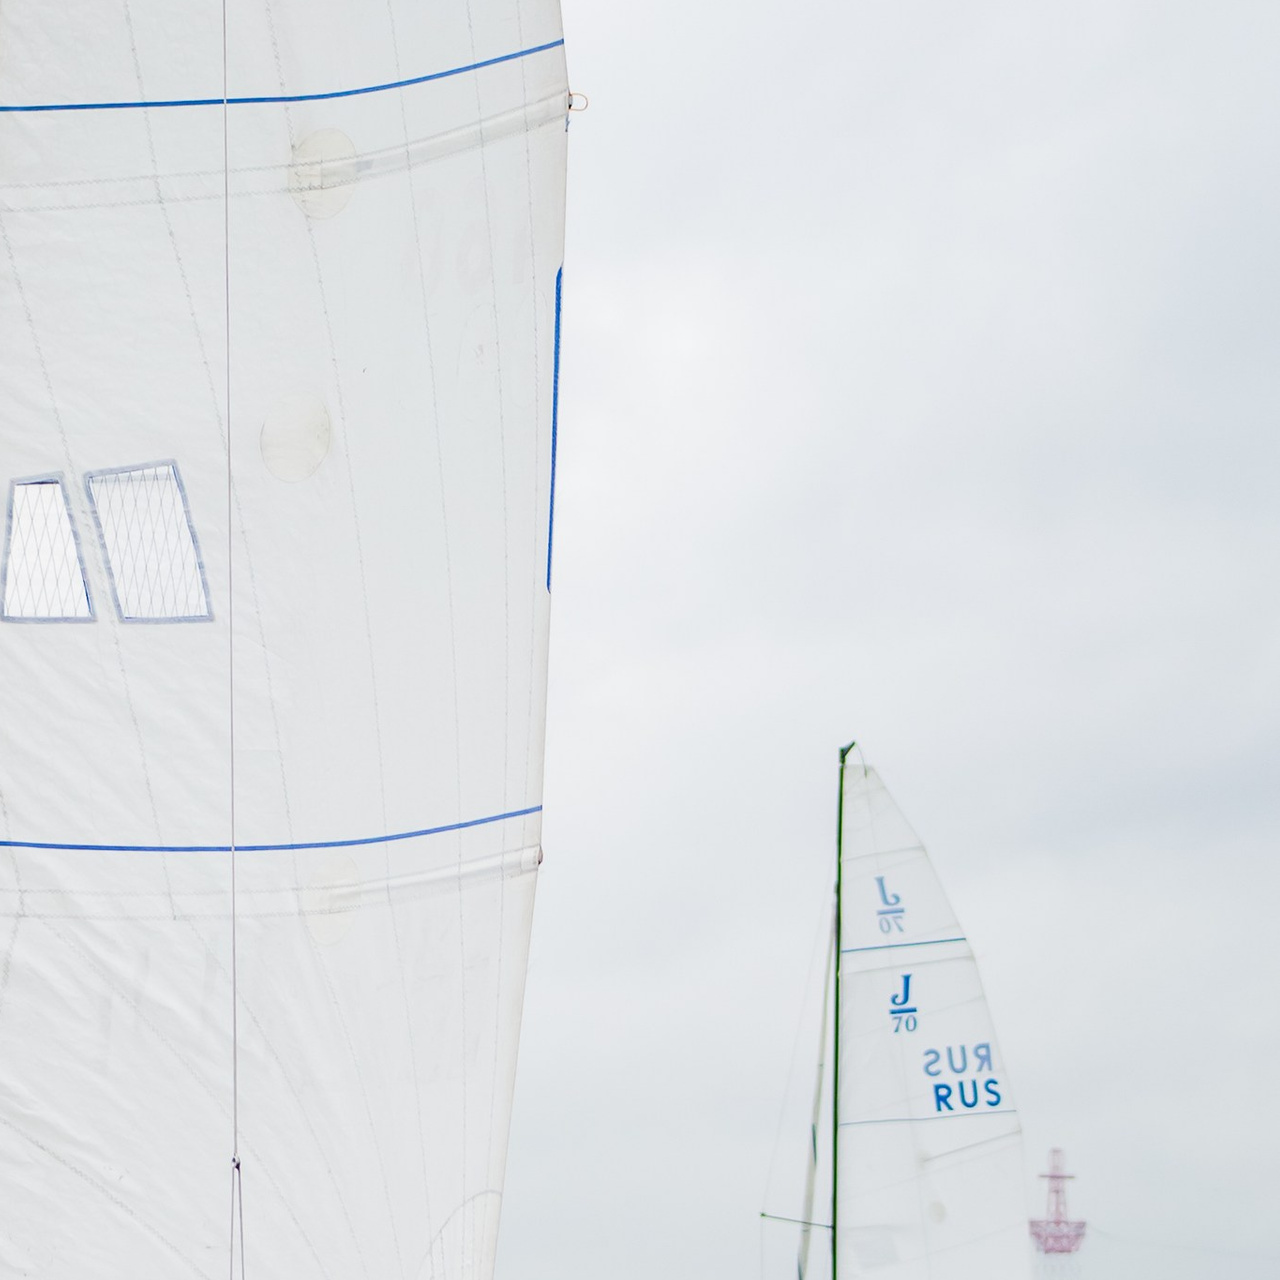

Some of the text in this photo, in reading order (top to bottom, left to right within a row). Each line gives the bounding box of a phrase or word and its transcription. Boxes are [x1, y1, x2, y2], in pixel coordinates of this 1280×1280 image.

[890, 974, 913, 1006] J
[892, 1015, 918, 1033] 70
[934, 1078, 1002, 1112] RUS
